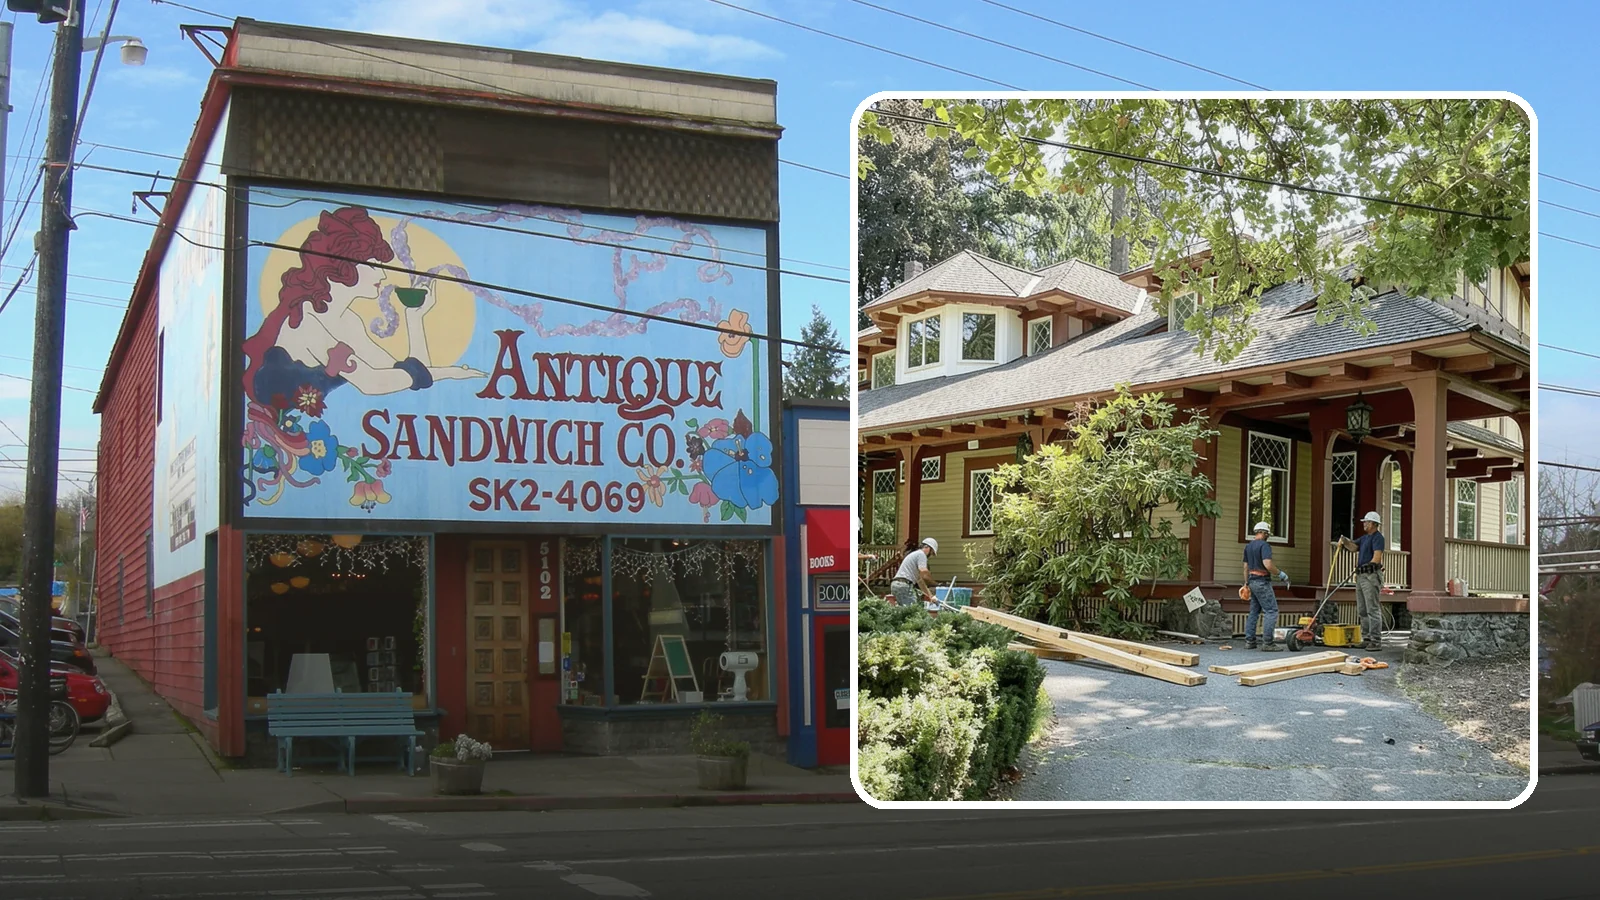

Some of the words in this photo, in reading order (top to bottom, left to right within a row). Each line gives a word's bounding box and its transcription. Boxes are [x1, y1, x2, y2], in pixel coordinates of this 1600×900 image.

[477, 329, 723, 420] ANTIQUE
[361, 409, 604, 467] SANDWICH
[617, 420, 686, 469] CO.
[468, 477, 646, 512] SK2-4069
[539, 541, 551, 600] 5102
[809, 555, 834, 569] BOOKS
